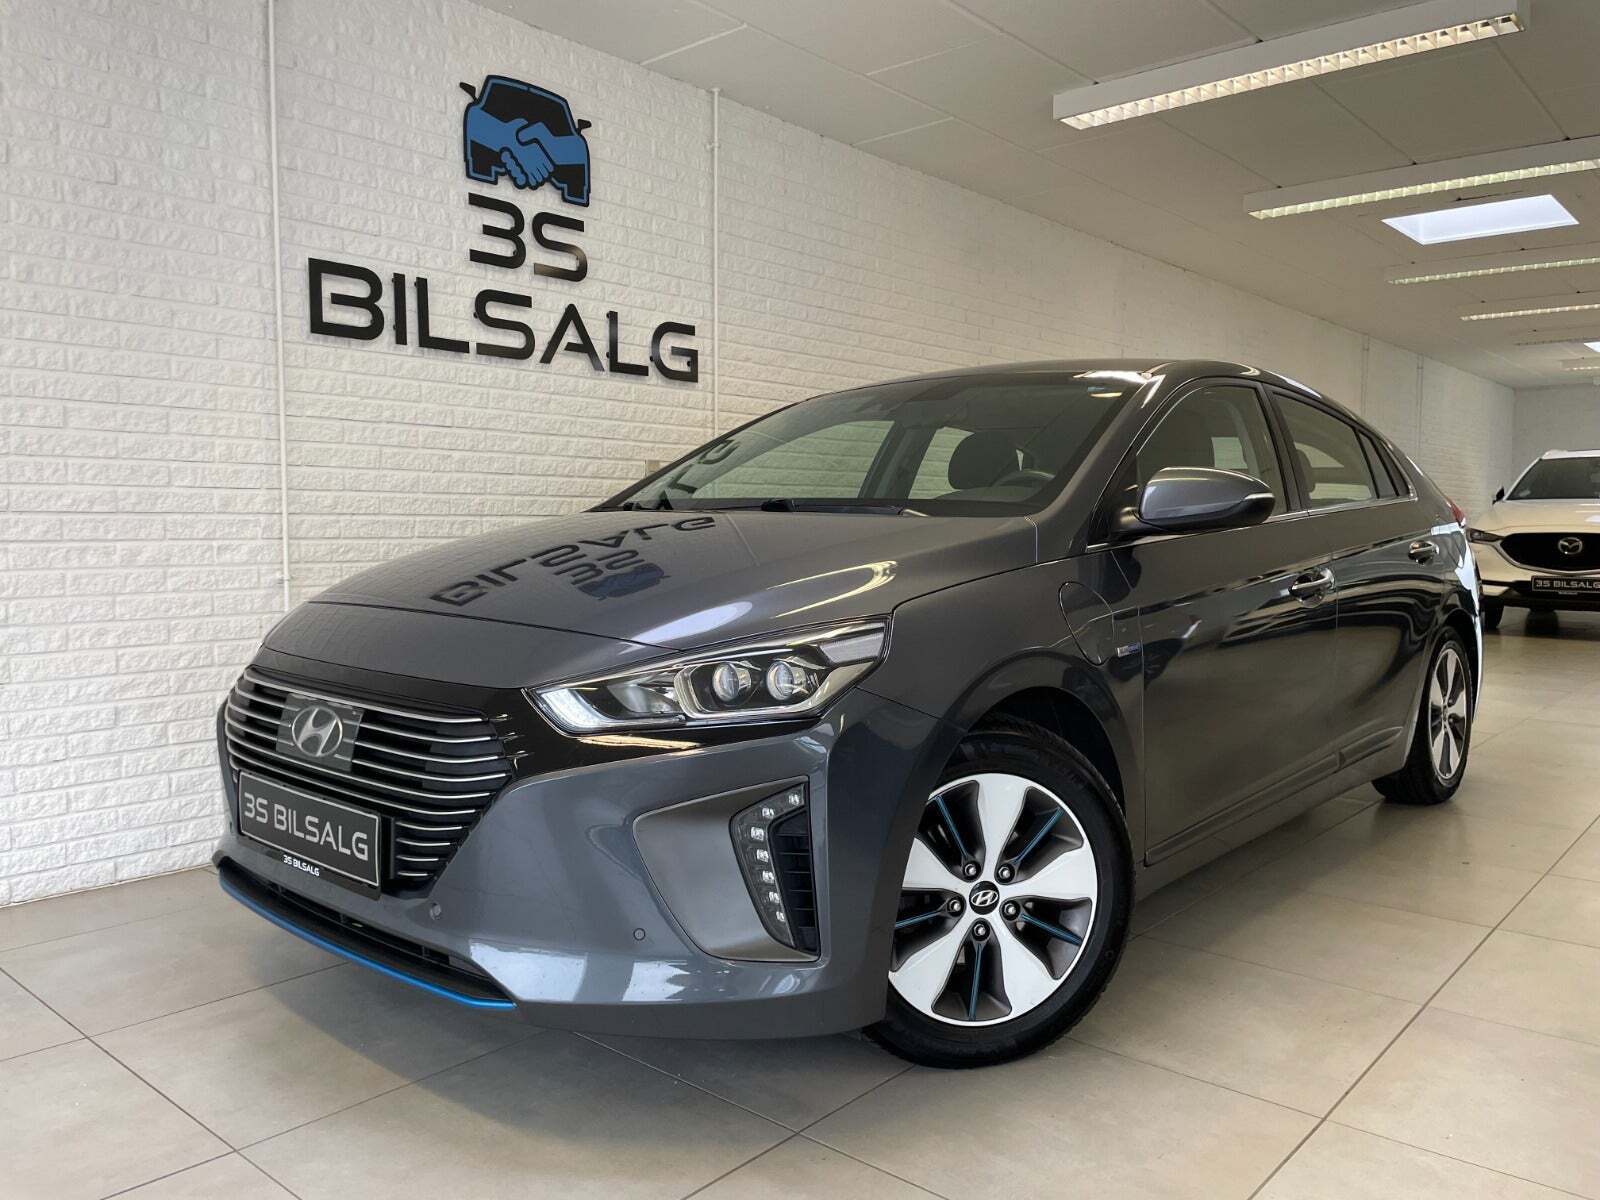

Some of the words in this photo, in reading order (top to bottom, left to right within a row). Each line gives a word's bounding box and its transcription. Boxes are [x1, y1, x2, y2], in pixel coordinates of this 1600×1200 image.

[468, 192, 587, 283] 3S
[308, 257, 698, 383] BILSALG
[244, 793, 268, 824] 3S
[274, 803, 368, 861] BILSALG
[283, 854, 292, 865] 3S
[292, 858, 320, 876] BILSALG
